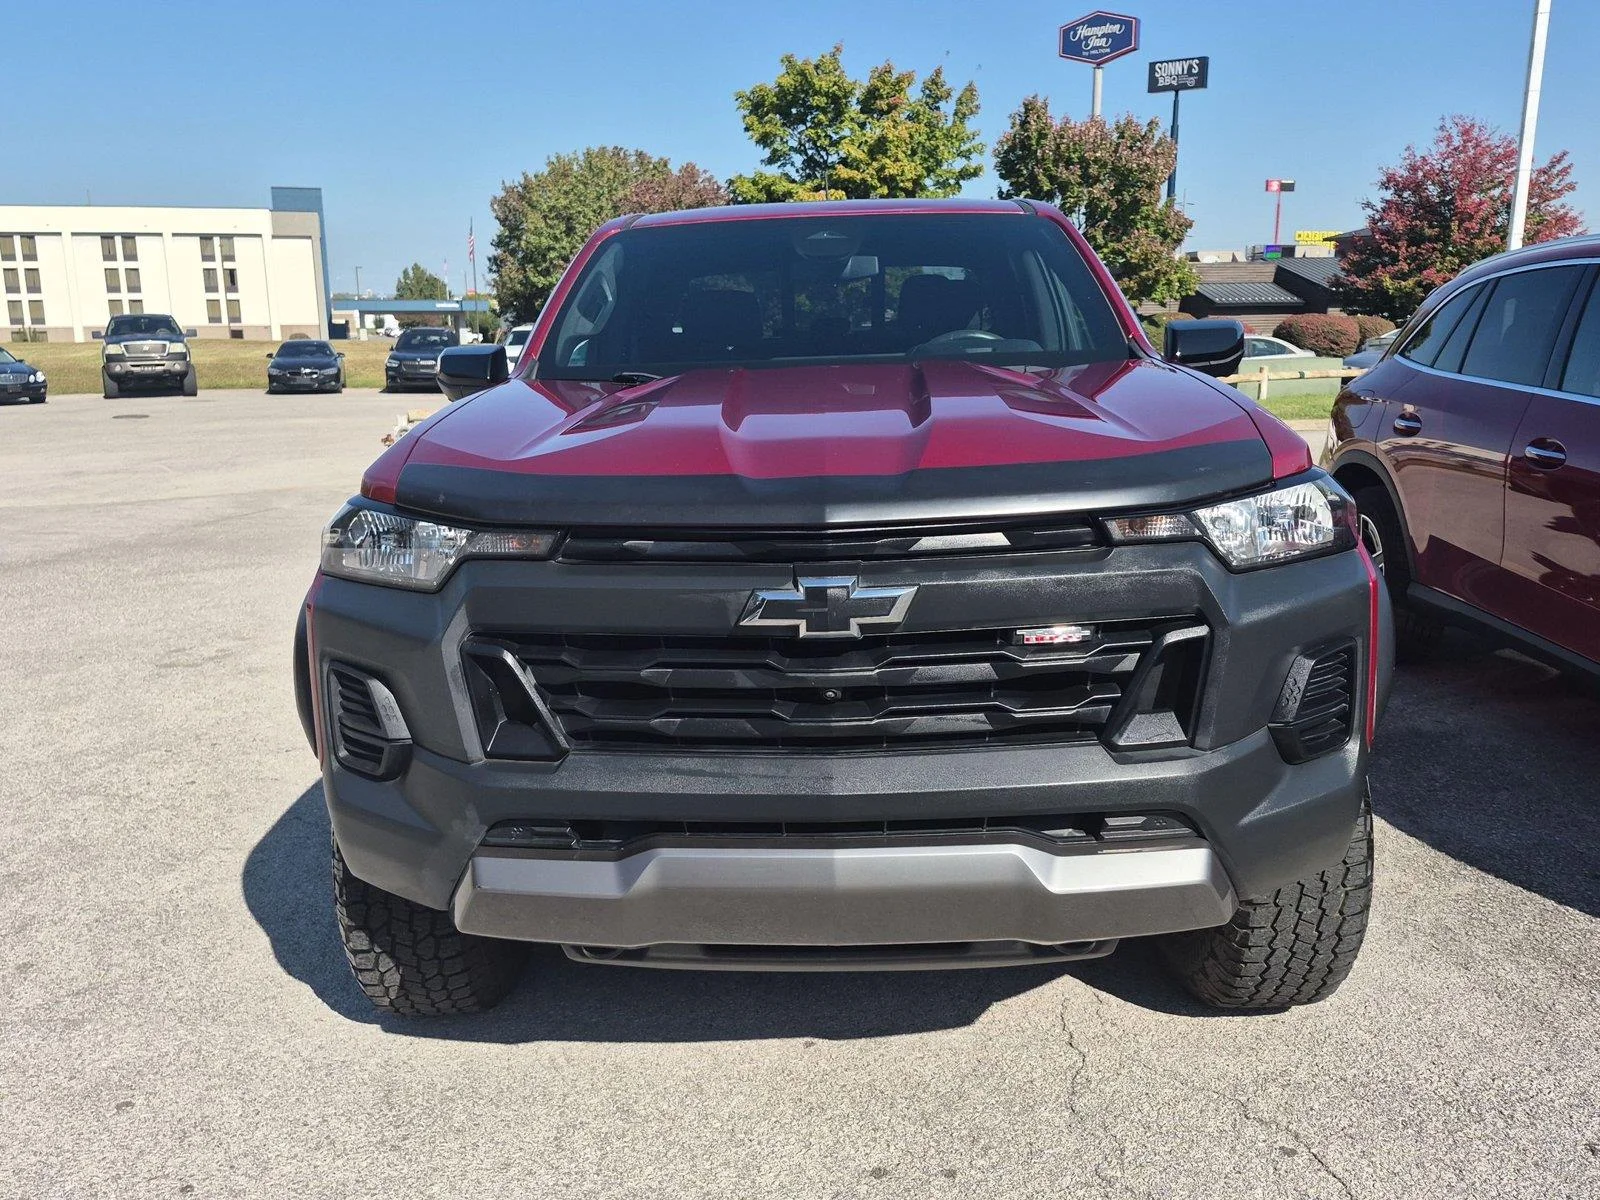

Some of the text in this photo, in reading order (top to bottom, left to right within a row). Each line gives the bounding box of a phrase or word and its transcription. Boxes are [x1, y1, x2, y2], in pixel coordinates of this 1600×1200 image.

[1070, 23, 1125, 41] Hampton
[1082, 37, 1111, 50] Inn
[1155, 59, 1199, 78] SONNY'S
[1157, 76, 1178, 87] BBQ
